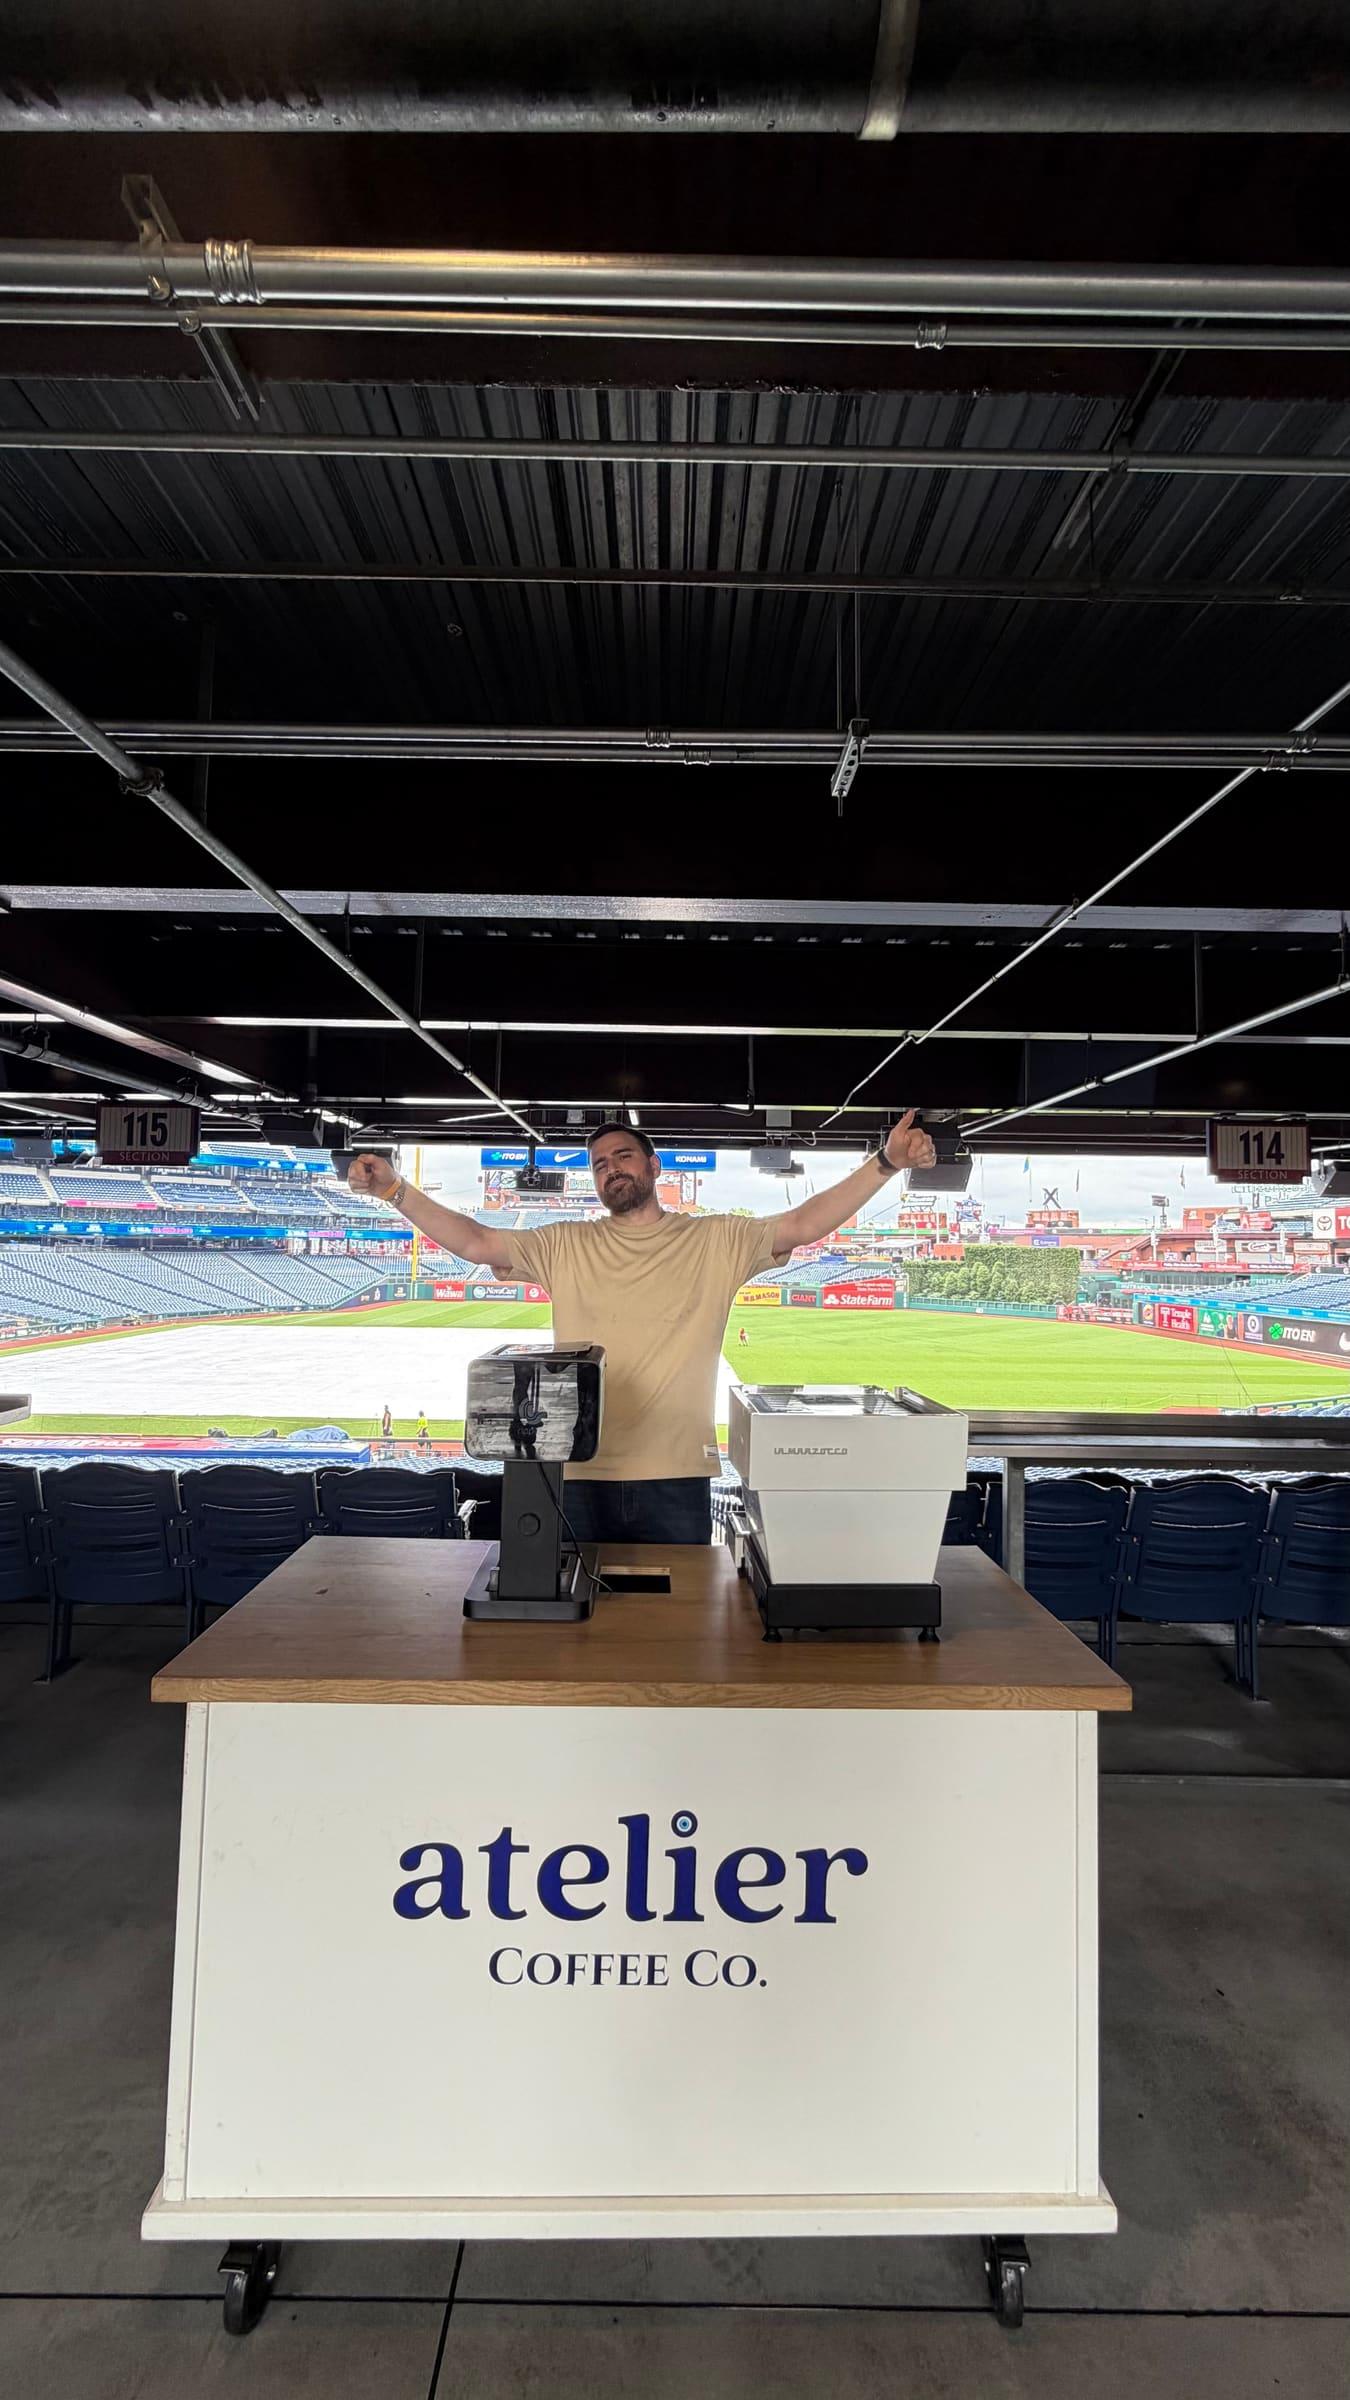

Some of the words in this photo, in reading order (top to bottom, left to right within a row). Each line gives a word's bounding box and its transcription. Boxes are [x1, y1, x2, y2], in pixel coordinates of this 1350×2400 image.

[123, 1112, 168, 1147] 115
[1239, 1130, 1285, 1165] 114
[120, 1151, 170, 1161] SECTION
[675, 1155, 707, 1163] KONAMI
[1238, 1169, 1288, 1179] SECTION
[436, 1286, 464, 1298] Wawa
[791, 1293, 816, 1302] GIANT
[393, 1809, 868, 1924] atelier
[488, 1947, 669, 1987] COFFEE
